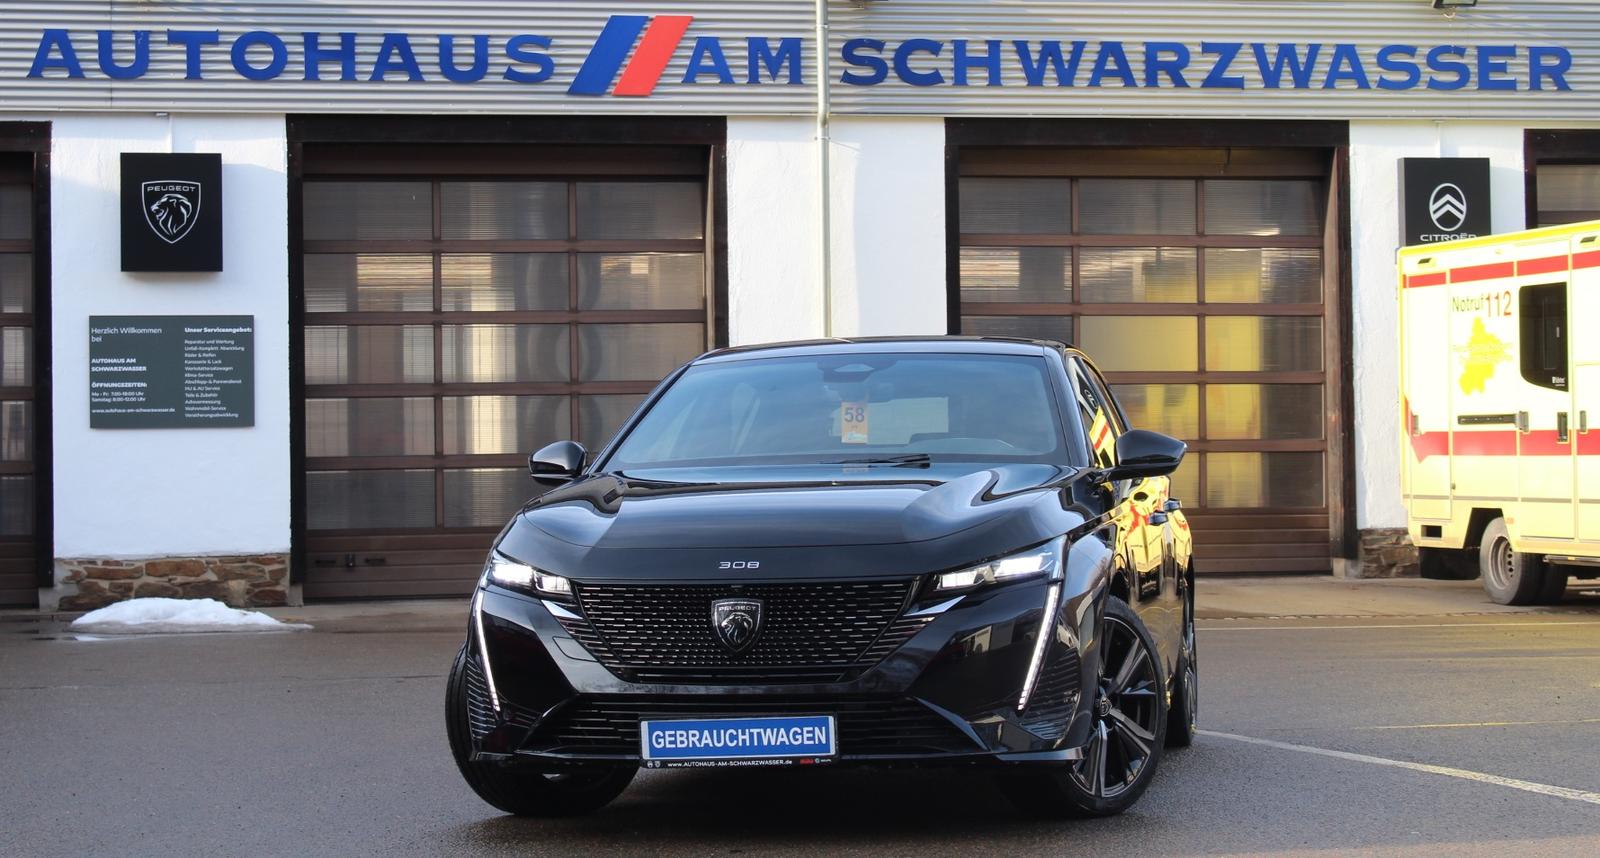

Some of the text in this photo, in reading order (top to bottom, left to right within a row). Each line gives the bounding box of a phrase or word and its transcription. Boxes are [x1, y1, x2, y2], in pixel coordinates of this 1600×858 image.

[26, 28, 1575, 92] AUTOHAUS AM SCHWARZWASSER
[1452, 290, 1512, 318] Notruf 112
[91, 327, 119, 335] Herzlich
[844, 407, 865, 423] 58
[719, 561, 760, 569] 308
[652, 726, 827, 749] GEBRAUCHTWAGEN
[667, 758, 793, 768] www.AUTOHAUS-AM-SCHWARZWASSER.de
